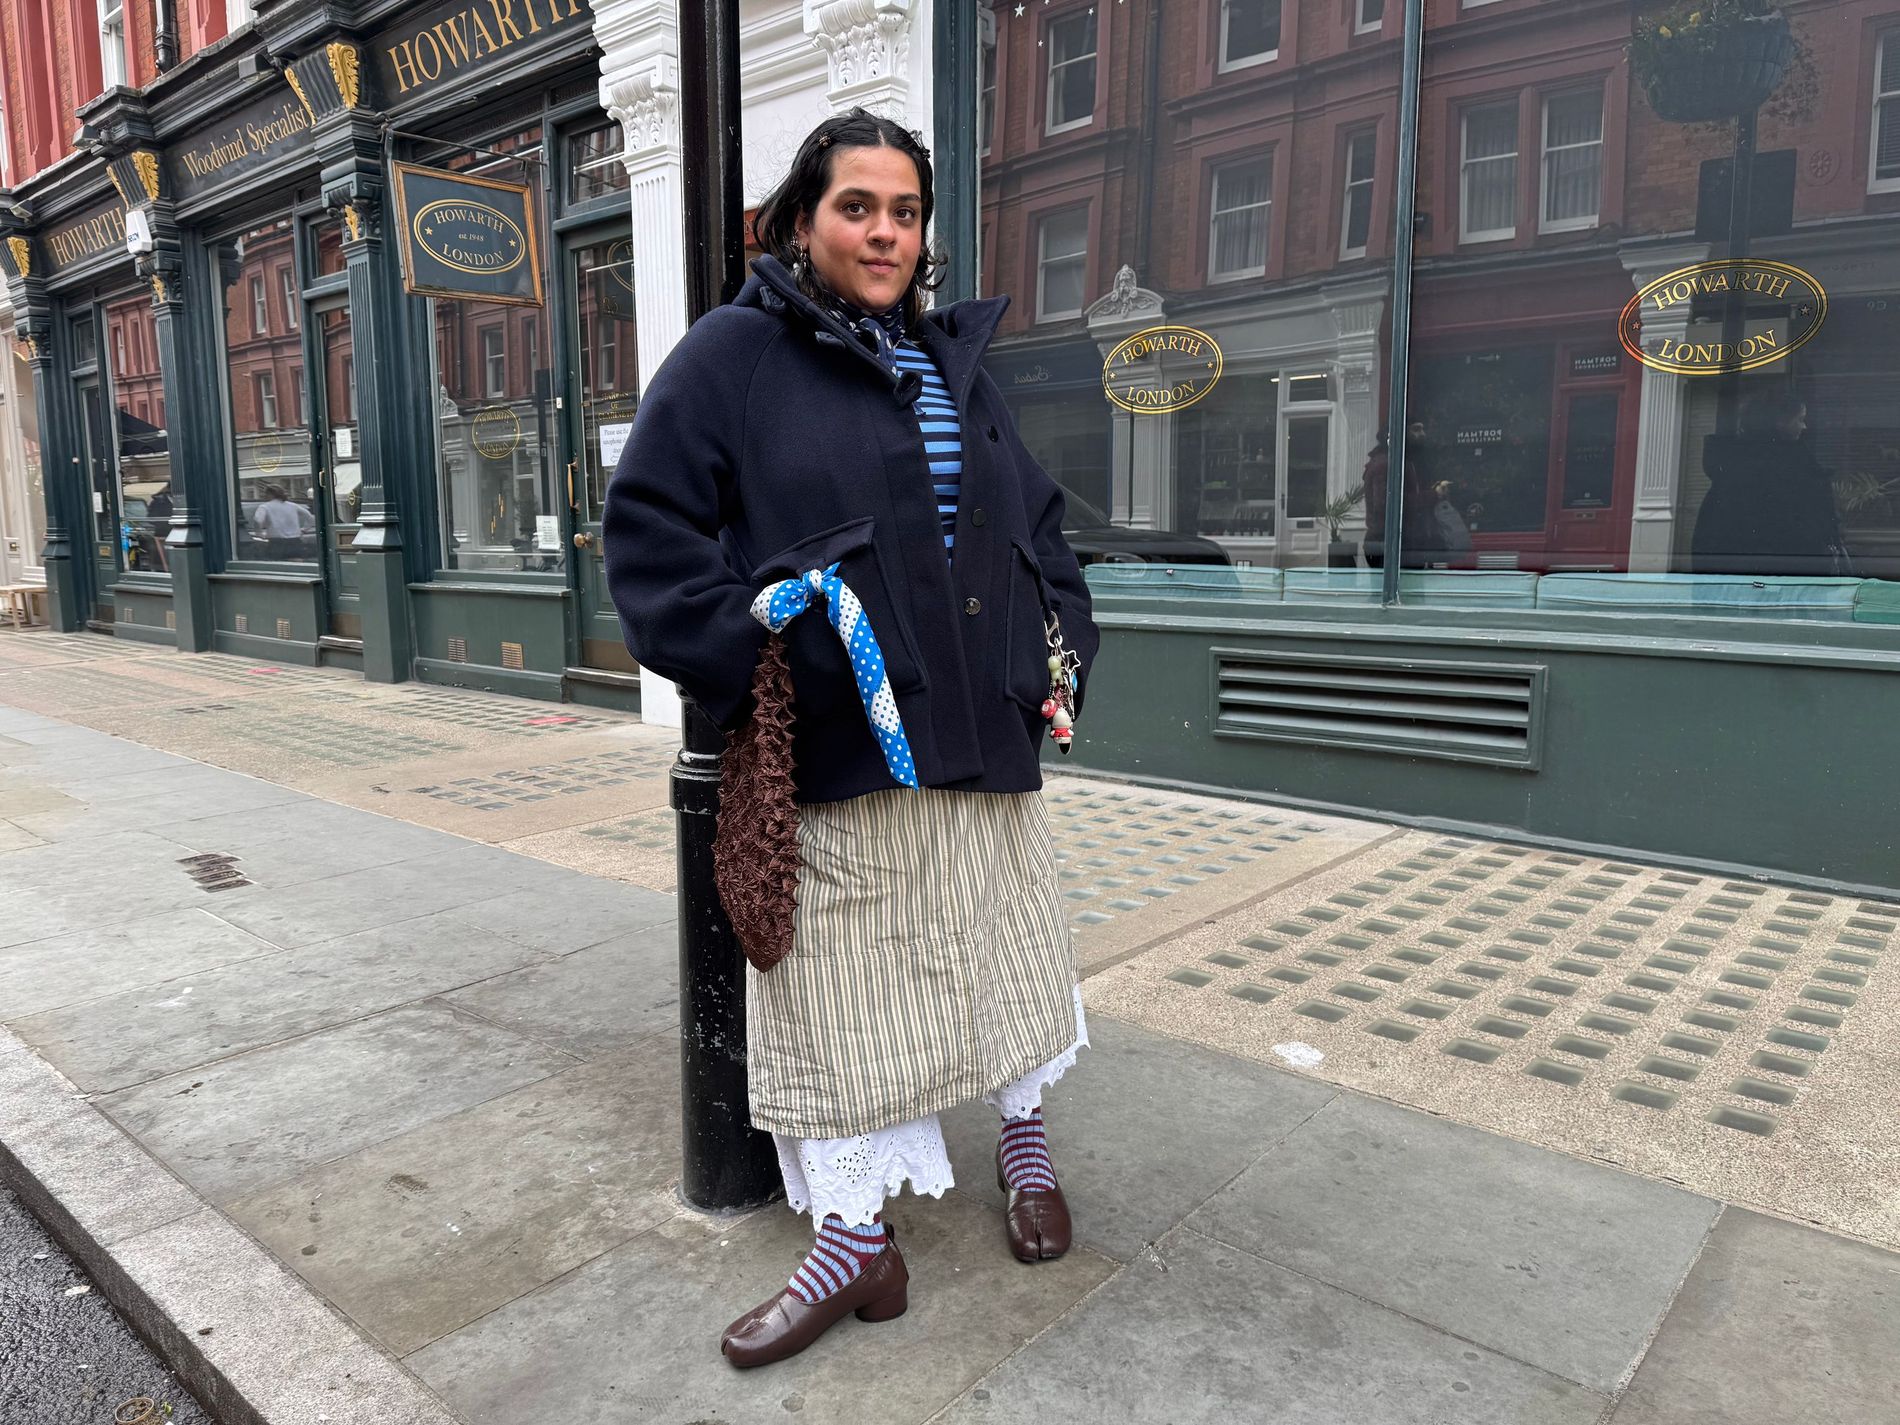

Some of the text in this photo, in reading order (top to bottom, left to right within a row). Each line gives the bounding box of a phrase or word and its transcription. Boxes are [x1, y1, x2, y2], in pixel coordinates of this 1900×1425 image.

[182, 103, 308, 178] Woodwind Specialist
[50, 207, 127, 266] HOWARTH
[434, 208, 504, 233] HOWARTH
[443, 243, 504, 266] LONDON
[1652, 271, 1791, 311] HOWARTH
[1121, 335, 1202, 365] HOWARTH
[1658, 329, 1777, 363] LONDON
[1126, 380, 1195, 405] LONDON
